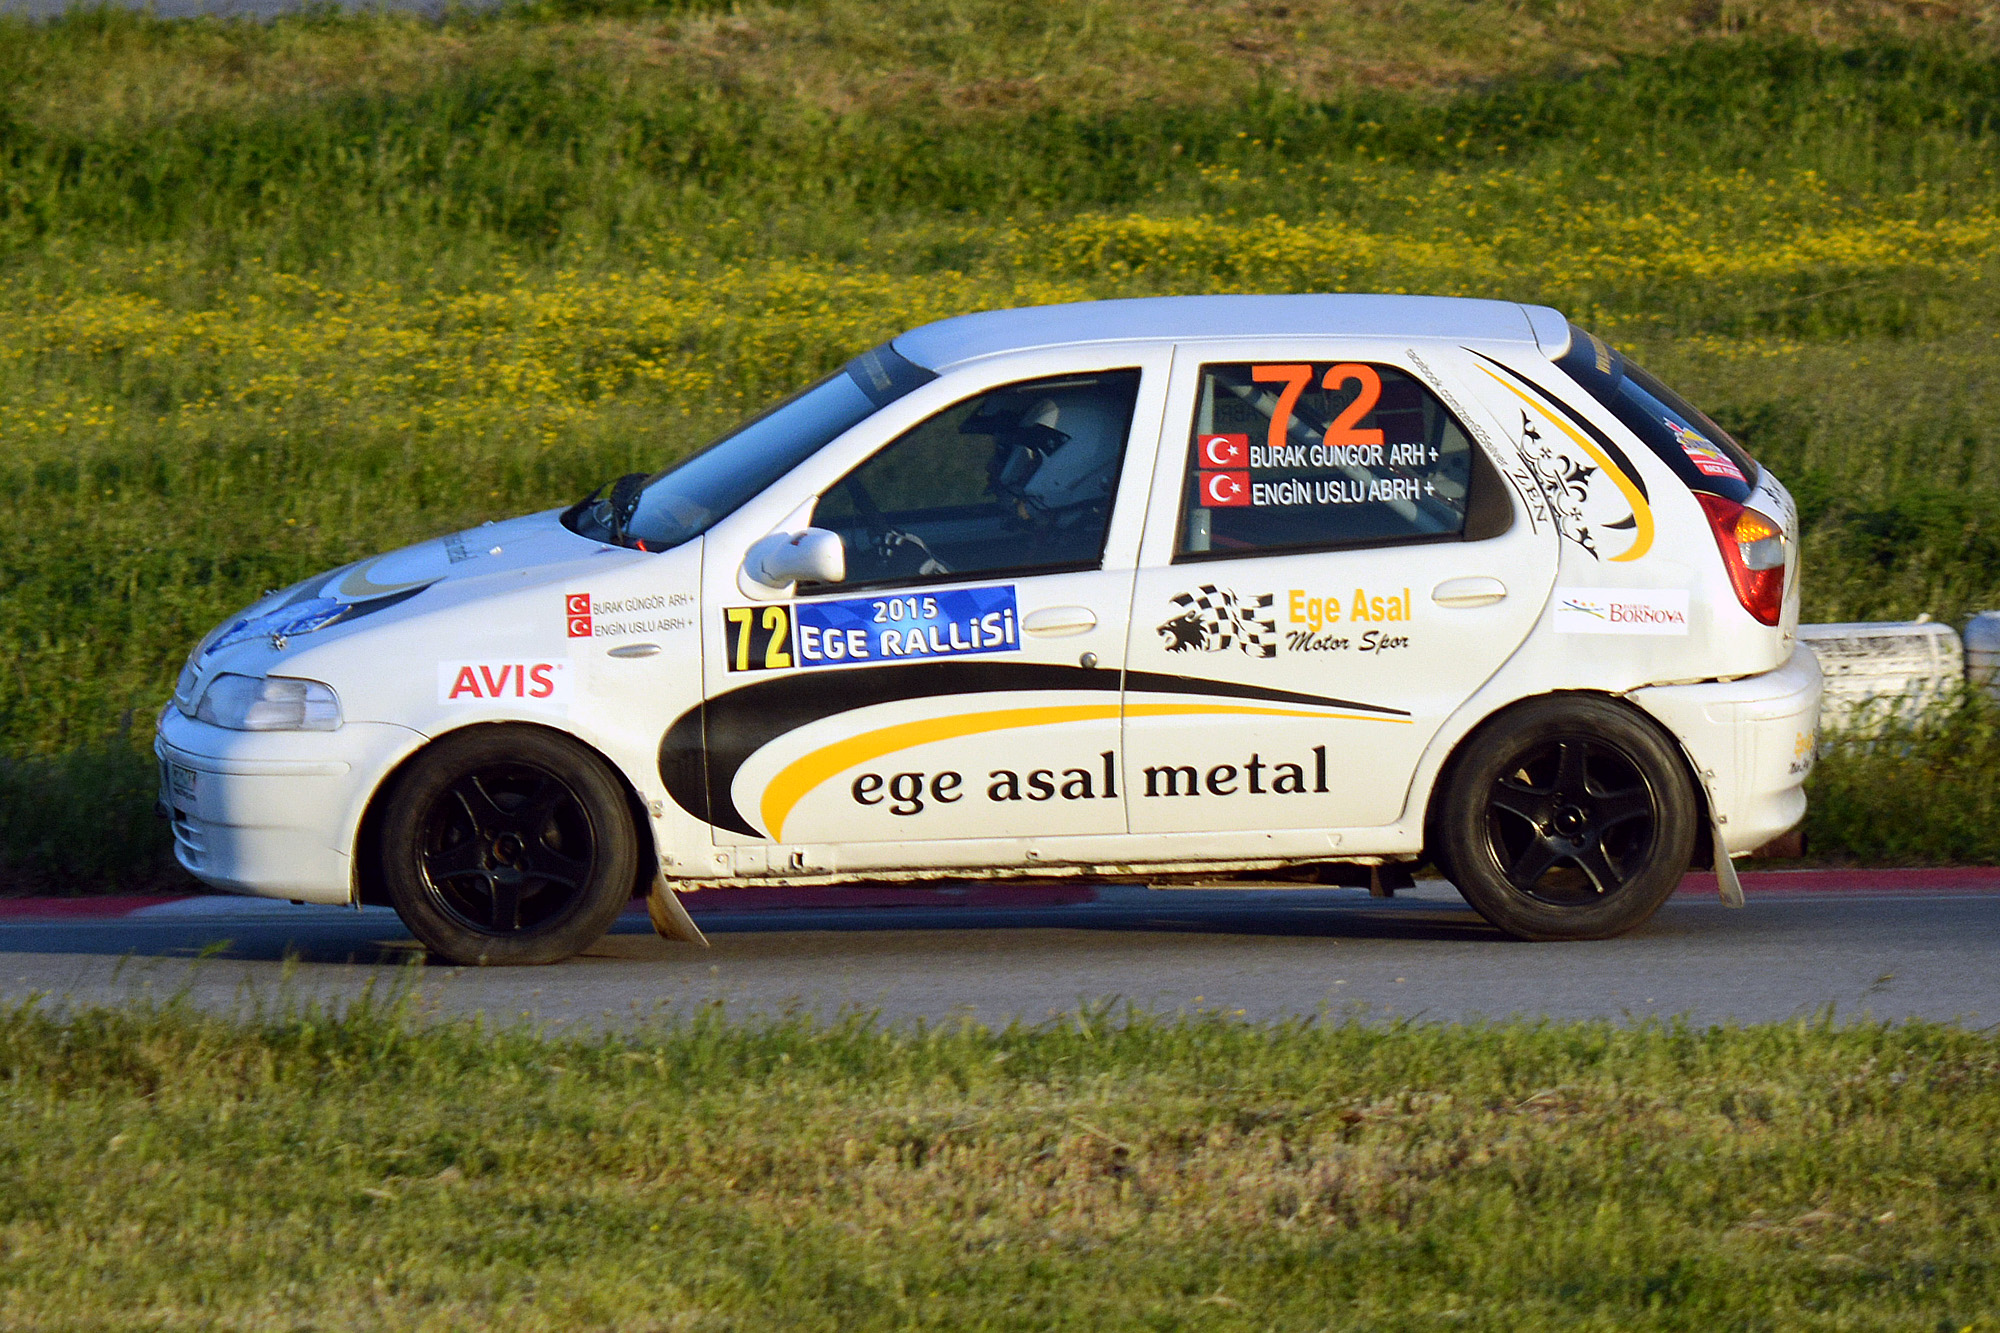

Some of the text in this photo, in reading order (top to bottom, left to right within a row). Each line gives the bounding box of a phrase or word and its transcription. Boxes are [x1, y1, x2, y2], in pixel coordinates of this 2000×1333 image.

[1251, 363, 1385, 446] 72
[1250, 445, 1308, 468] BURAK
[1390, 443, 1425, 466] ARH
[1252, 478, 1312, 506] ENGİN
[1315, 480, 1366, 504] USLU
[1368, 477, 1421, 502] ABRH
[1513, 468, 1548, 523] ZEN
[592, 600, 624, 615] BURAK
[668, 593, 688, 607] ARH
[872, 597, 939, 624] 2015
[1288, 587, 1411, 632] Ege Asal
[628, 619, 655, 634] USLU
[656, 617, 685, 631] ABRH
[728, 606, 792, 671] 72
[800, 624, 869, 660] EGE
[1284, 630, 1410, 654] Motor Spor
[851, 744, 1331, 816] ege asal metal
